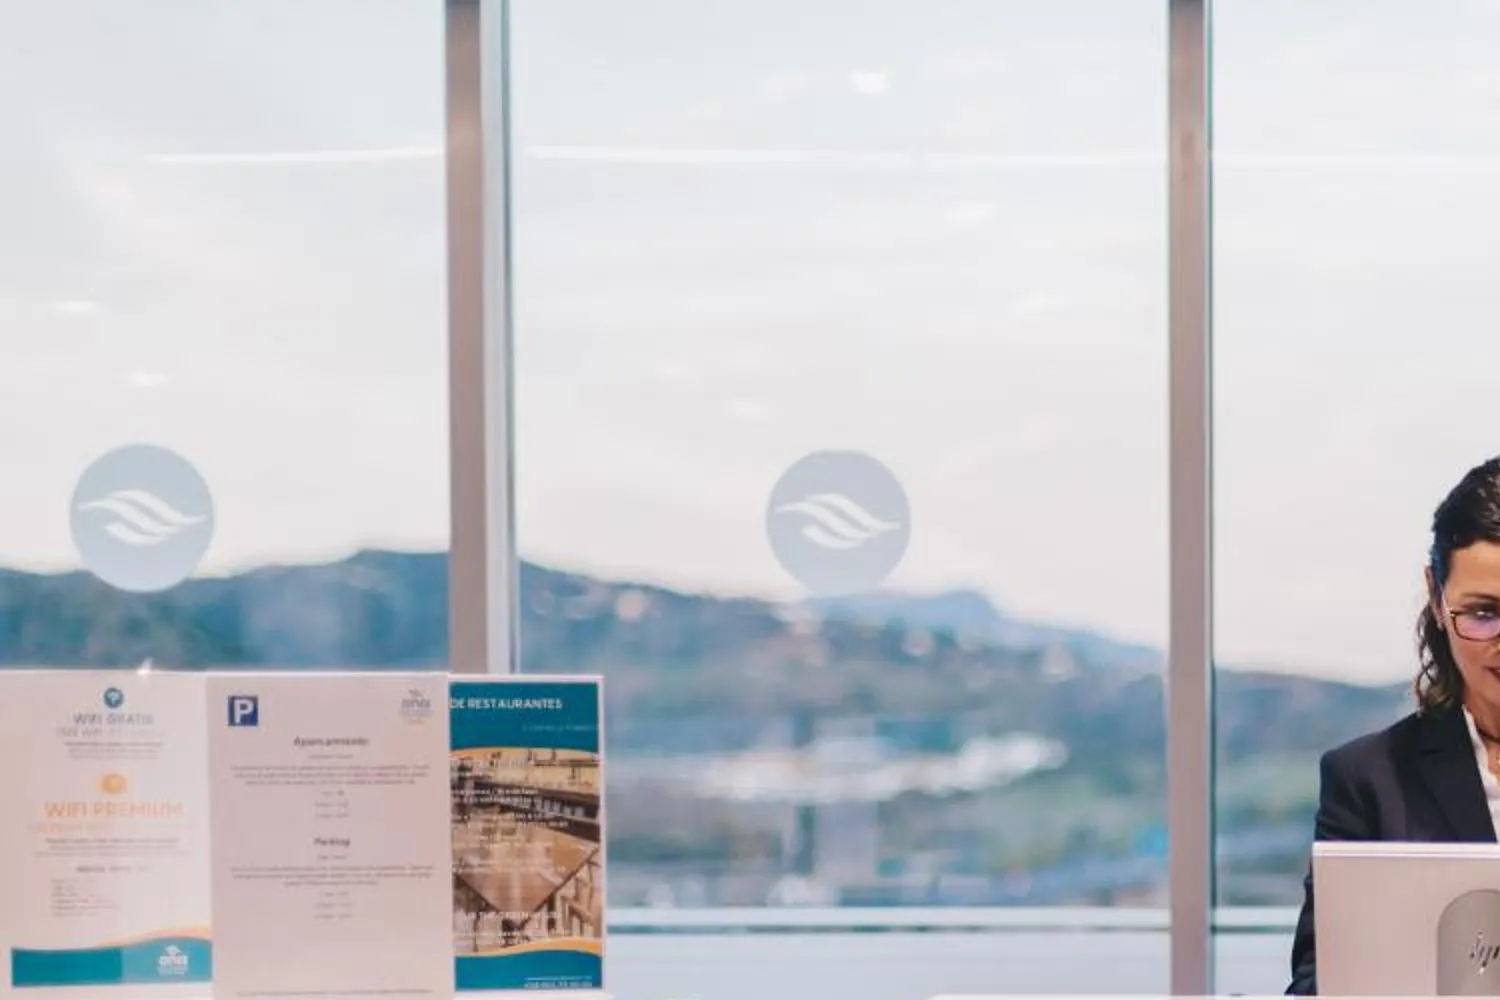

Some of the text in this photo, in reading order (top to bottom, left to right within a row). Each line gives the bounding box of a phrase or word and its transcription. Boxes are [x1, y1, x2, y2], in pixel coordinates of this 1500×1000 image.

[234, 699, 255, 724] P
[468, 698, 563, 710] RESTAURANTES
[45, 801, 184, 817] WIFI PREMIUM
